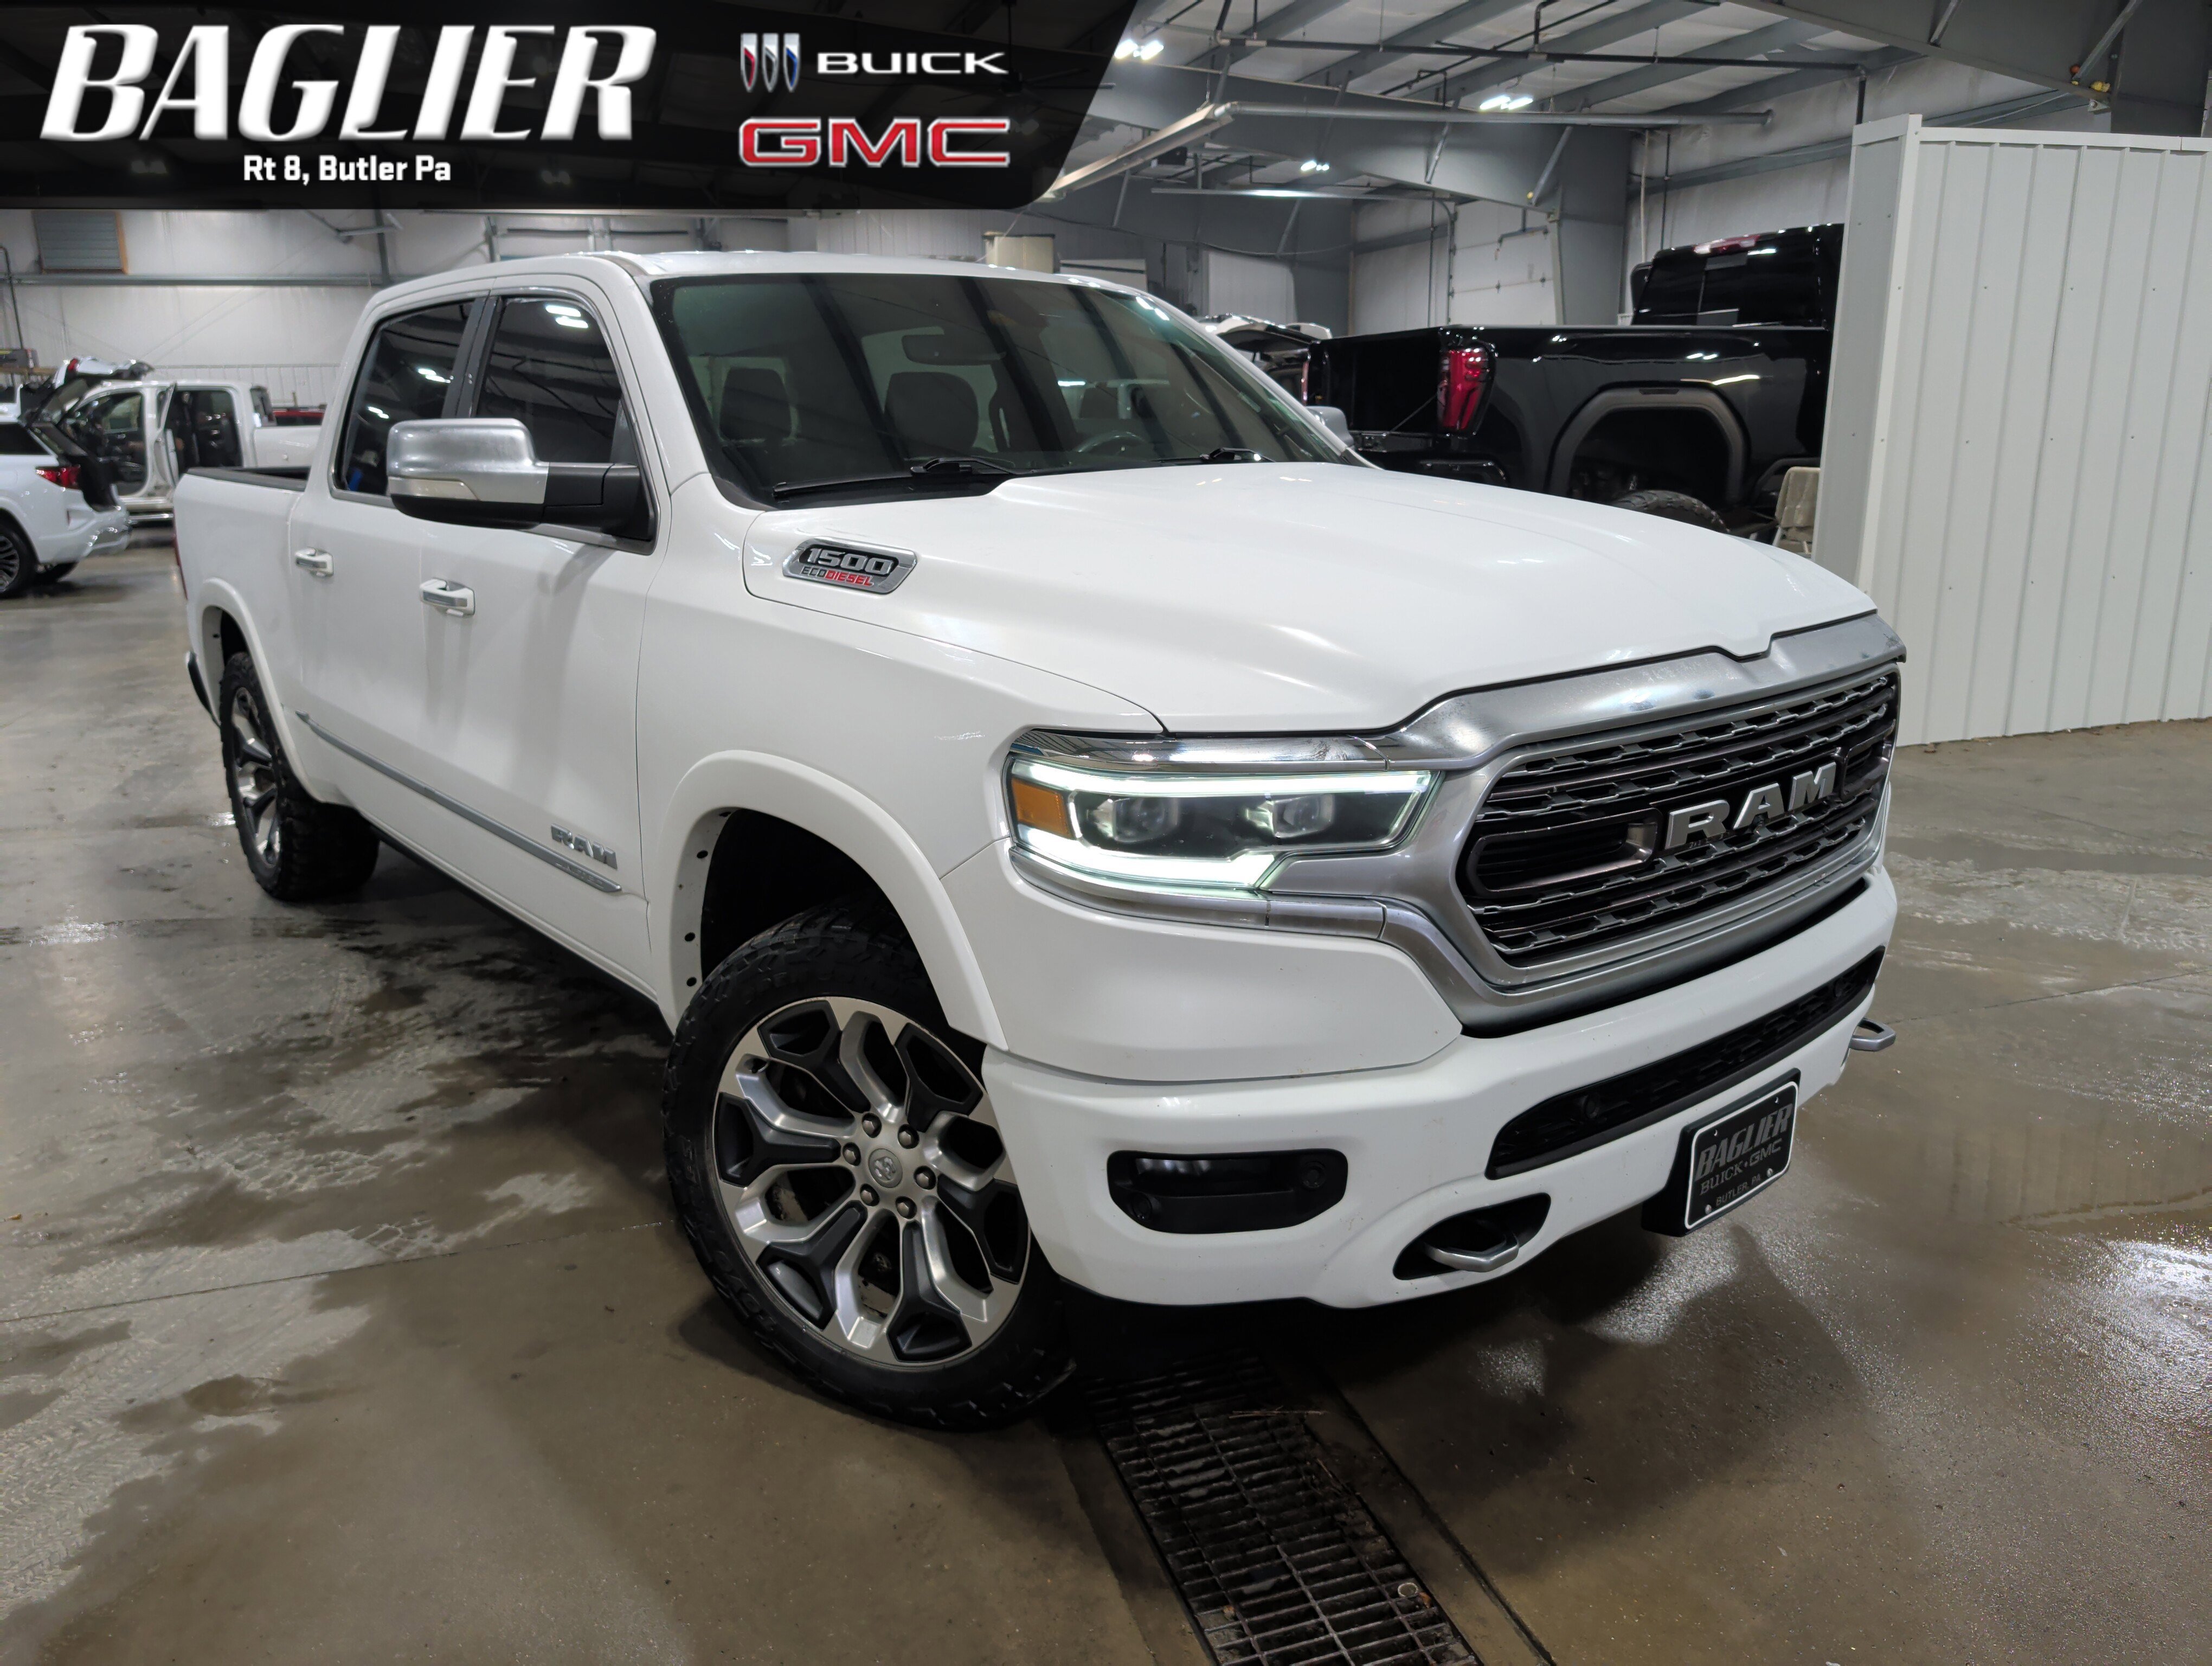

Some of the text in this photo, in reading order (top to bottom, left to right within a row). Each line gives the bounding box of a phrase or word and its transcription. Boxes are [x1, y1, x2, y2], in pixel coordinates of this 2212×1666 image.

[800, 565, 874, 586] ECODIESEL
[807, 547, 895, 575] 1500
[1664, 761, 1837, 850] RAM
[551, 823, 618, 870] RAM
[1695, 1103, 1793, 1182] BAGLIER
[1700, 1138, 1783, 1195] BUICK GMC
[1751, 1173, 1761, 1185] PA
